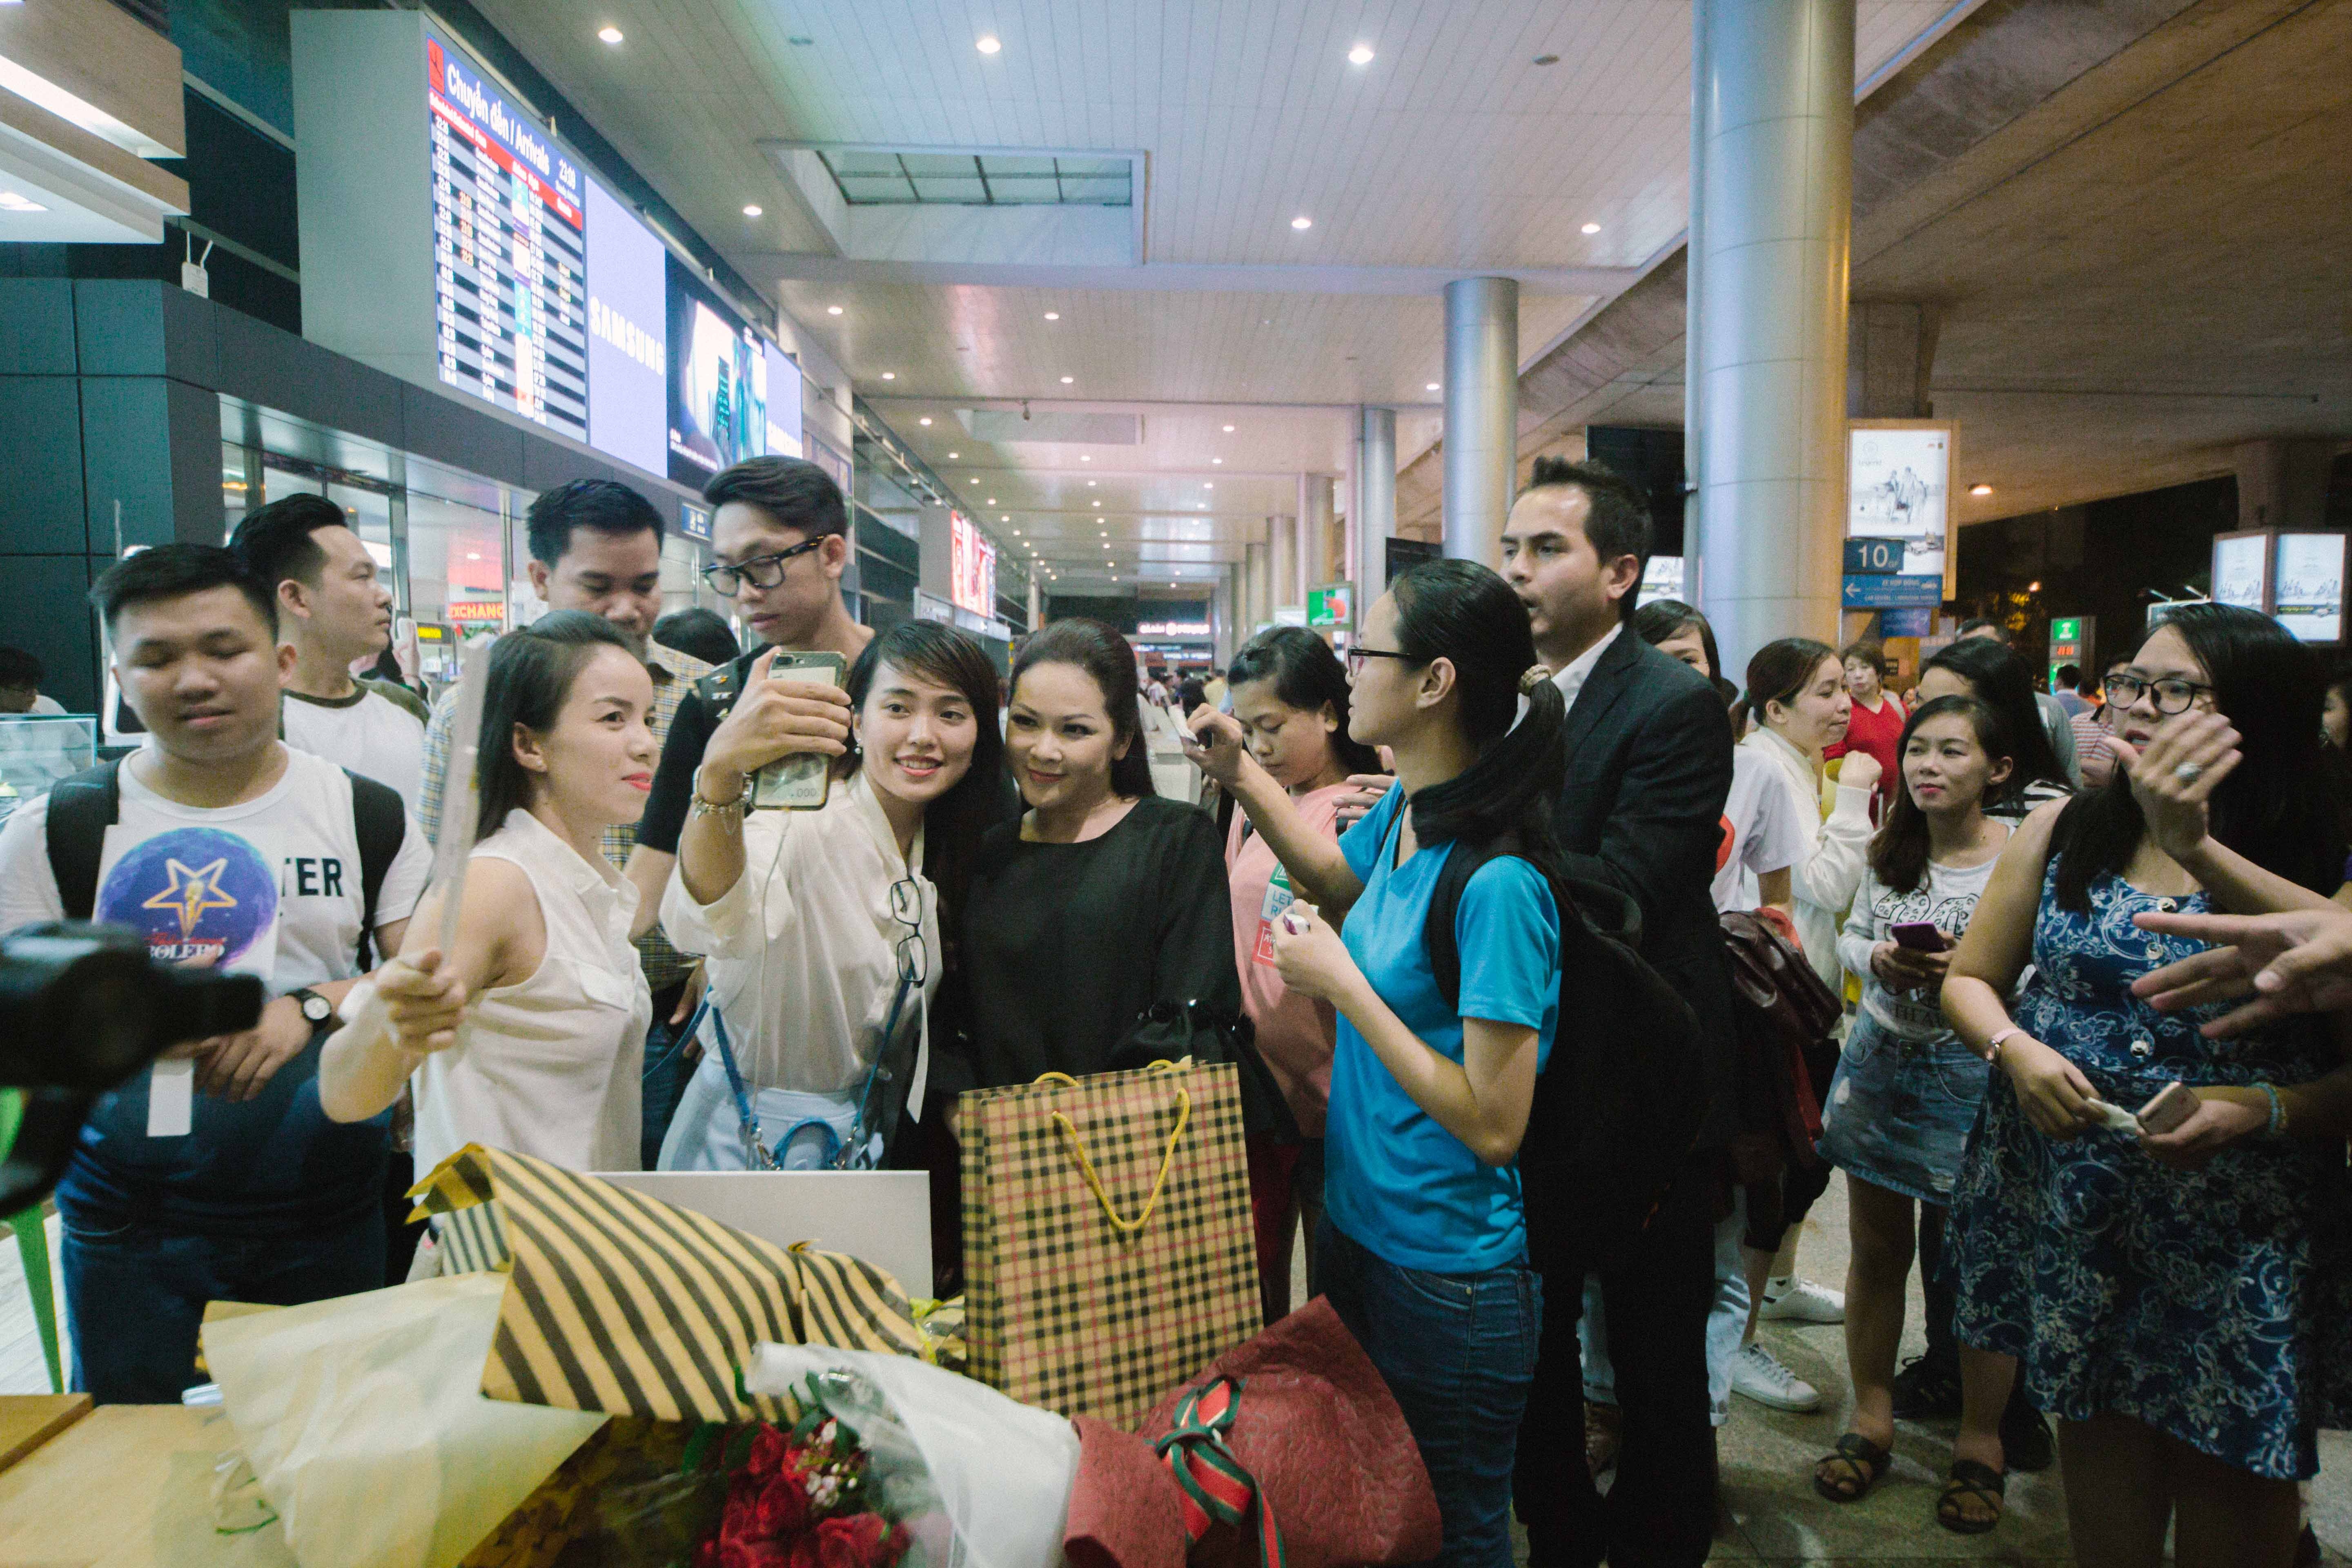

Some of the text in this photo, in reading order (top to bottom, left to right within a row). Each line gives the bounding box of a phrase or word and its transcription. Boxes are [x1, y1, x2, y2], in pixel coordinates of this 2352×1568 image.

[515, 124, 550, 176] Arrivals
[590, 296, 664, 376] SAMSUNG
[1859, 544, 1888, 568] 10
[282, 858, 344, 897] ER
